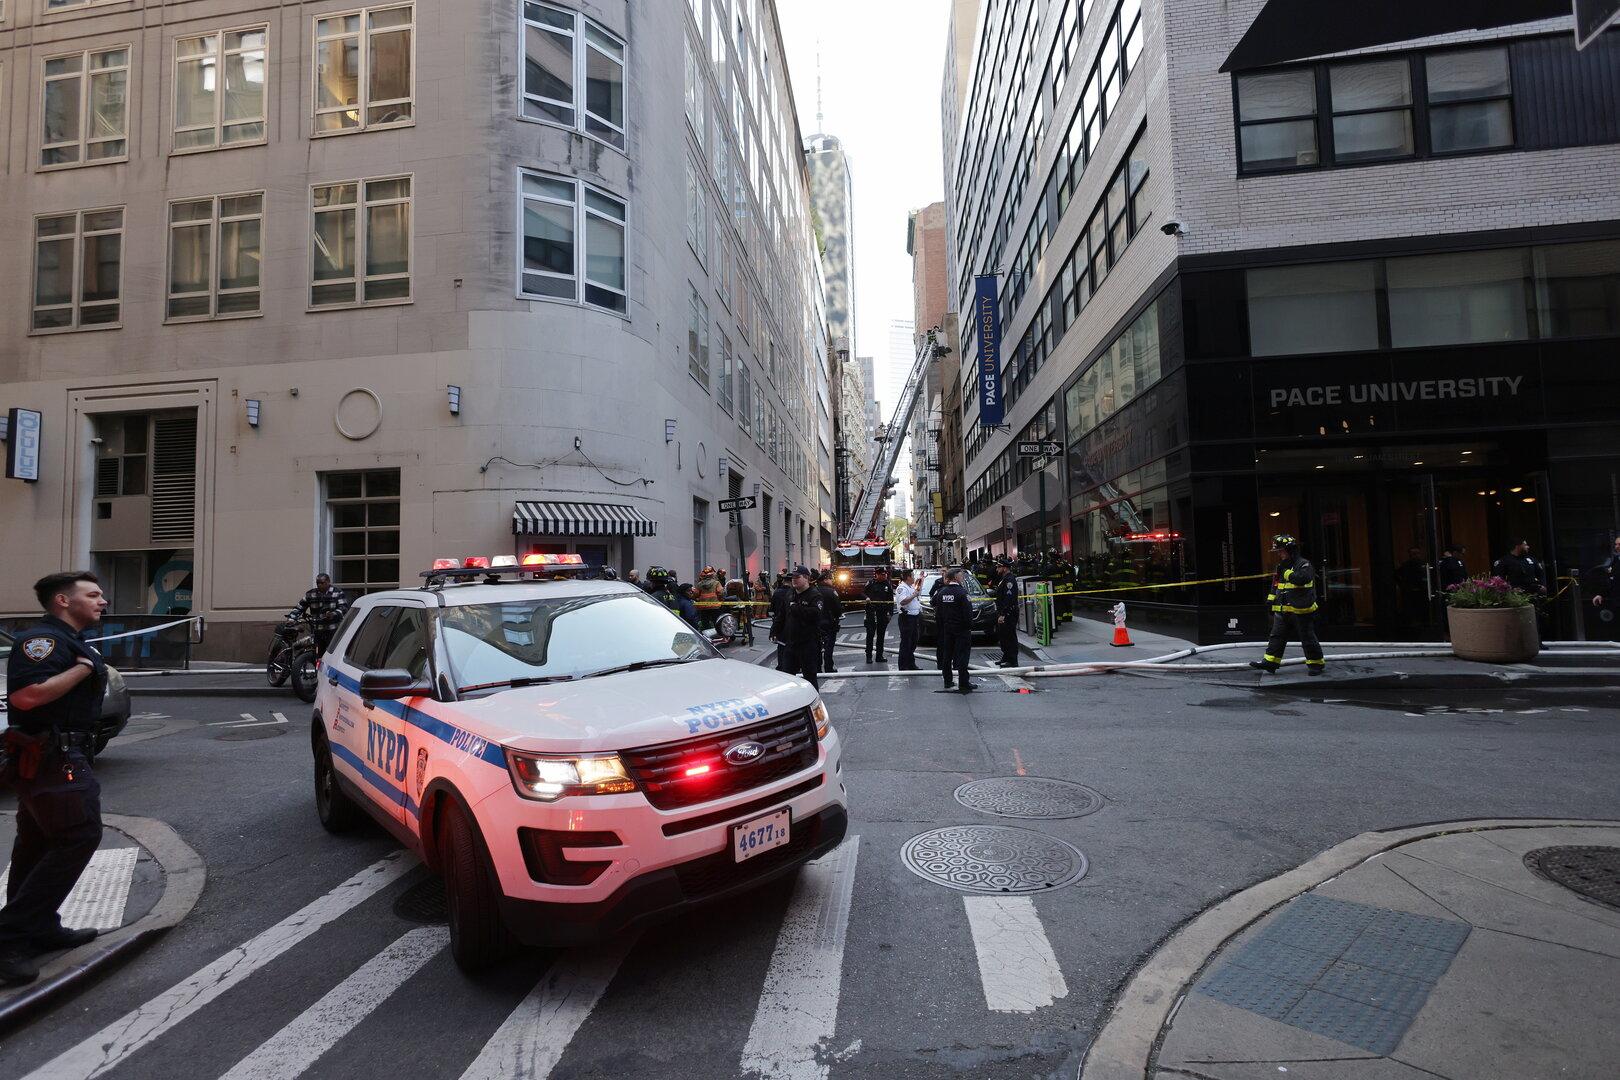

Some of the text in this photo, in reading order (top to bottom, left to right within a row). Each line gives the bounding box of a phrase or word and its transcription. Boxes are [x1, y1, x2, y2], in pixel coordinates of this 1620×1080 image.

[983, 296, 996, 406] PACE UNIVERSITY
[1270, 375, 1523, 408] PACE UNIVERSITY
[685, 703, 770, 734] POLICE
[686, 699, 745, 714] NYPD
[367, 719, 409, 782] NYPD
[450, 728, 488, 758] POLICE
[736, 745, 759, 758] Ford
[739, 824, 786, 851] 4677 18
